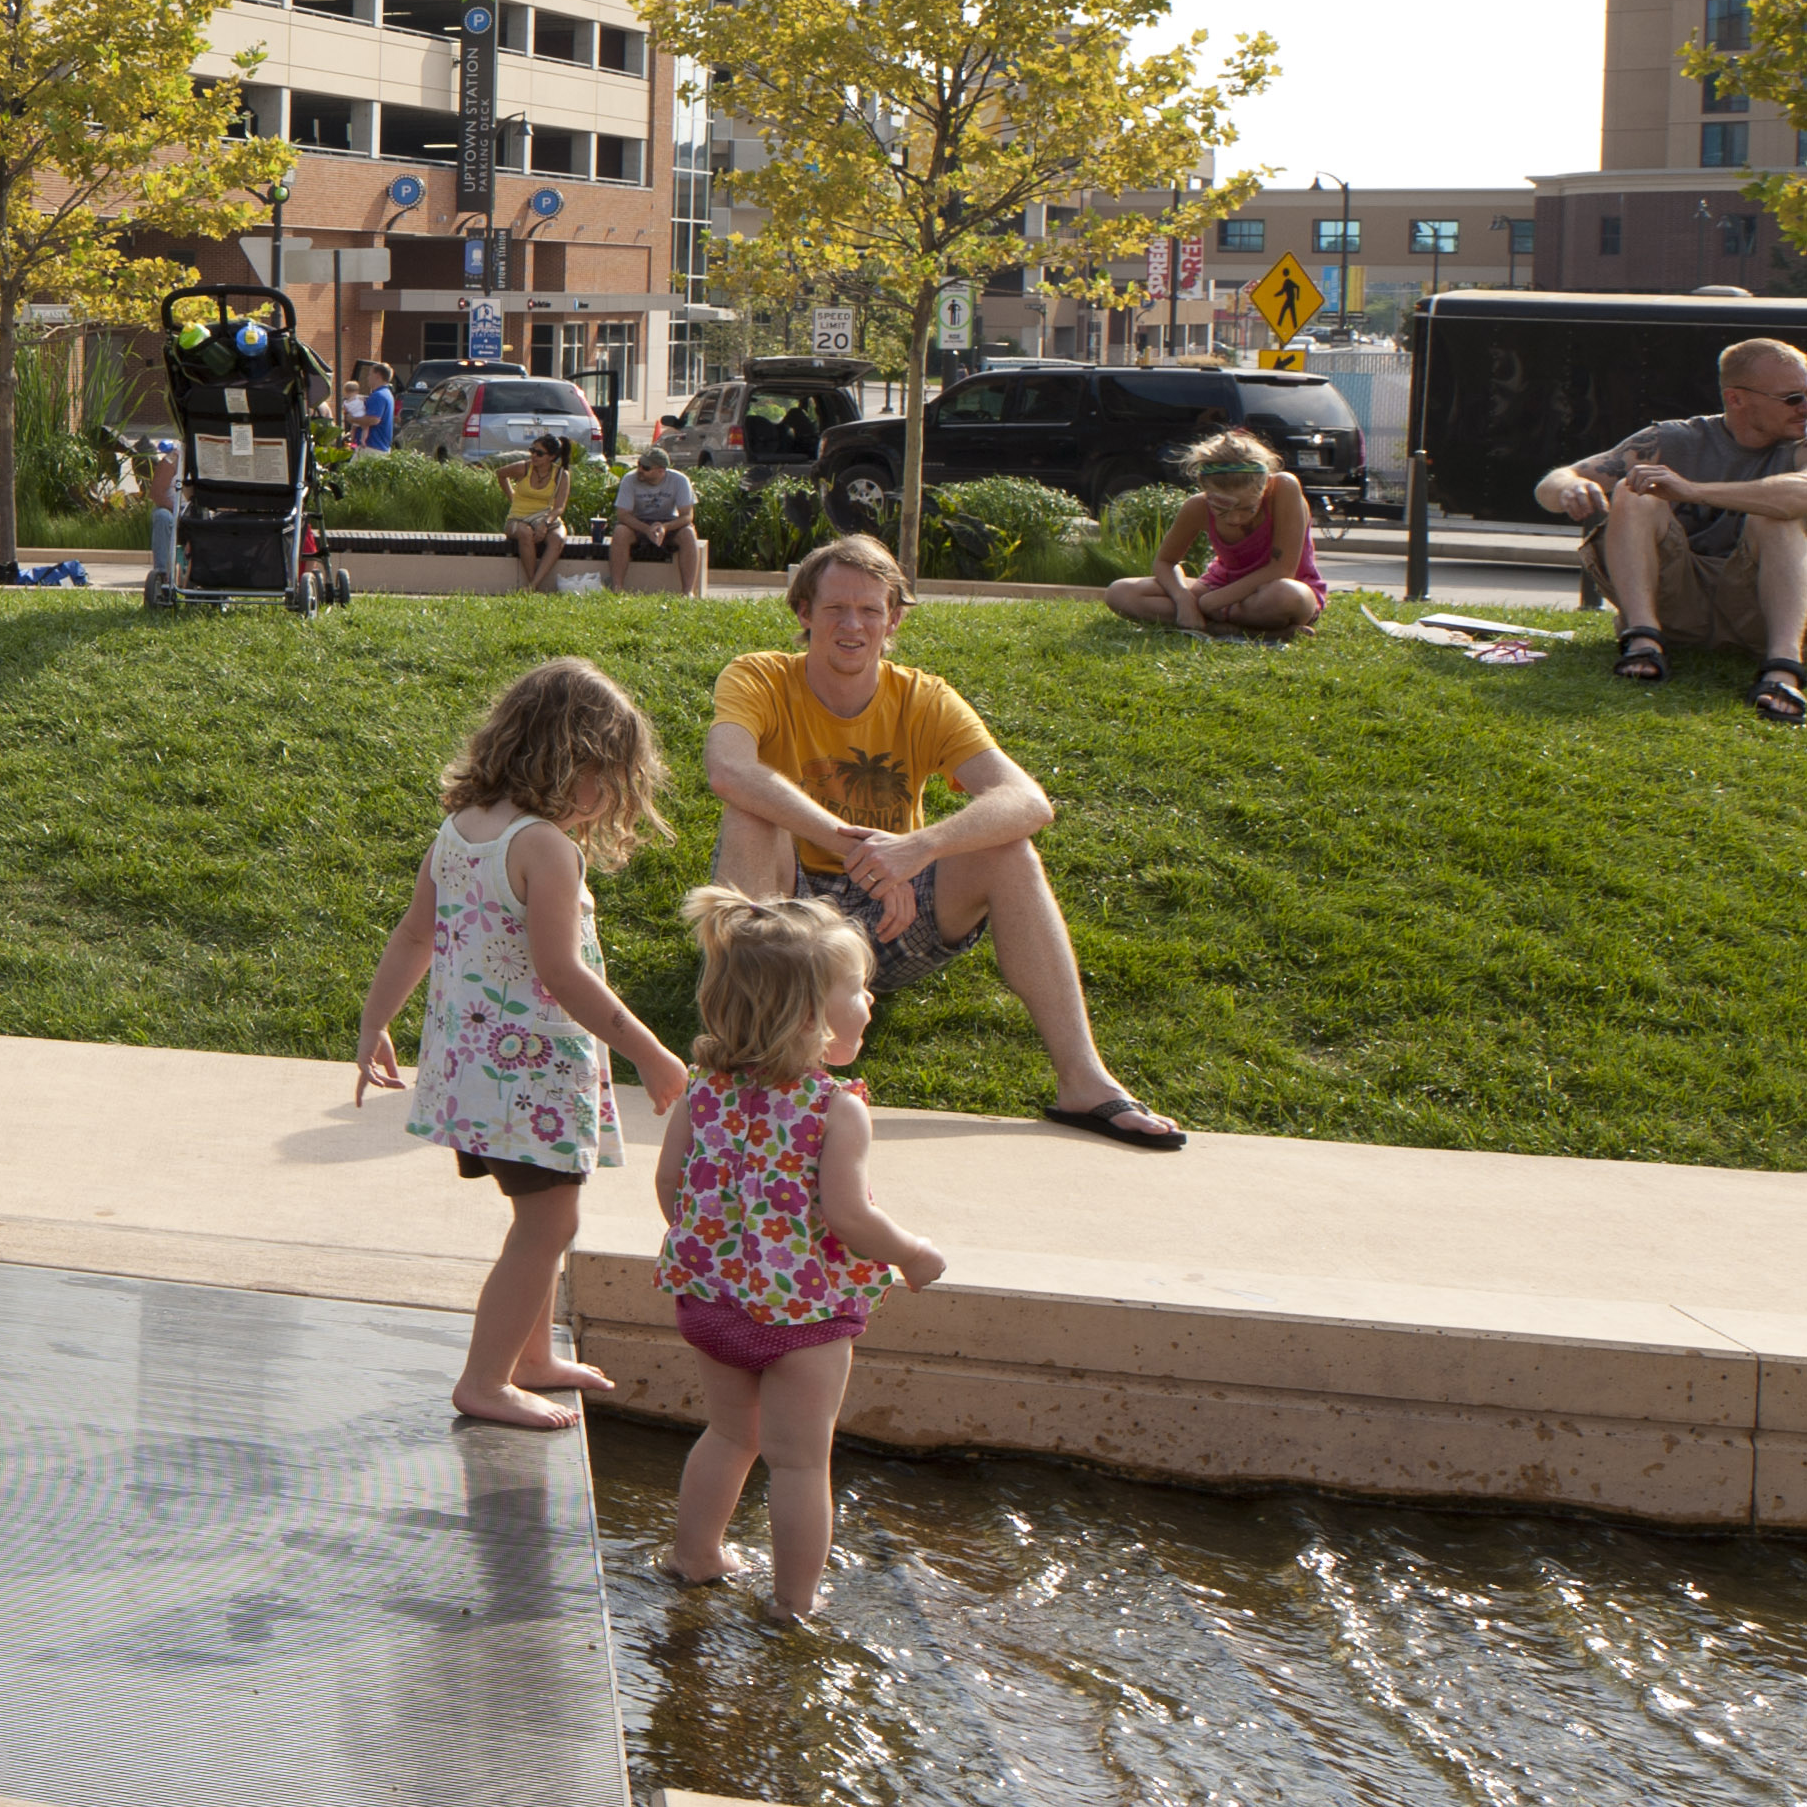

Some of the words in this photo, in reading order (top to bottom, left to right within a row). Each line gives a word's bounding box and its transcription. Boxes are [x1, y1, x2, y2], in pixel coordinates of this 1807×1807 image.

[473, 13, 485, 26] P
[465, 47, 479, 115] STATION
[480, 98, 490, 131] DECK
[464, 120, 477, 192] UPTOWN
[479, 139, 489, 192] PARKING
[401, 185, 412, 198] P
[541, 197, 552, 208] P
[817, 312, 851, 321] SPEED
[820, 321, 847, 330] LIMIT
[817, 332, 849, 350] 20
